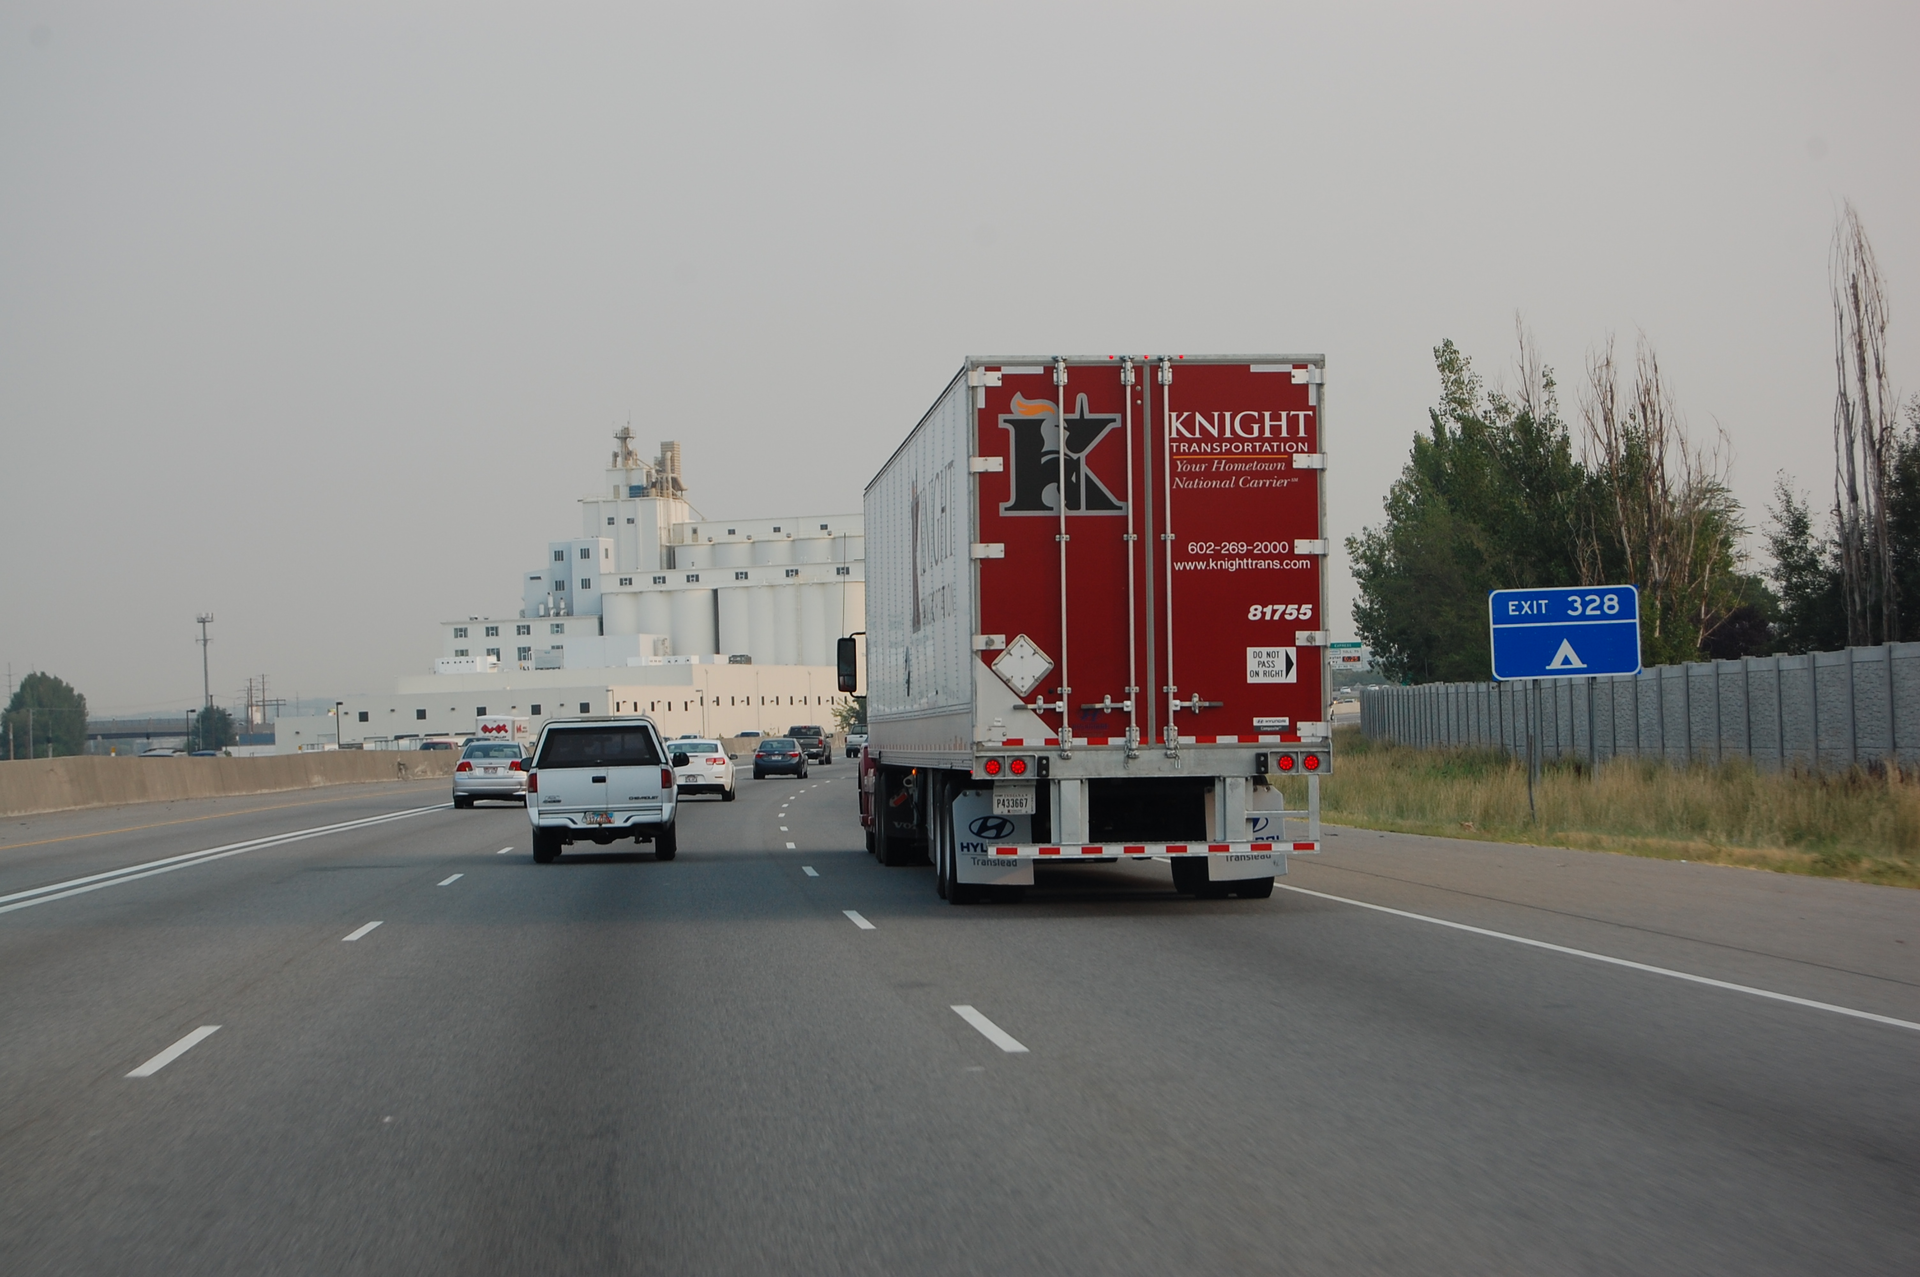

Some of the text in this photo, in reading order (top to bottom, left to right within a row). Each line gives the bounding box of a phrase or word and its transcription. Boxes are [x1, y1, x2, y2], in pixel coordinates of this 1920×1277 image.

[1169, 410, 1313, 438] KNIGHT
[1170, 442, 1308, 453] TRANSPORTATION
[1176, 459, 1286, 472] Your Hometown
[1172, 476, 1236, 489] National
[1187, 541, 1289, 554] 602-269-2000
[1173, 557, 1311, 572] www.knighttrans.com
[1508, 594, 1620, 616] EXIT 328
[1247, 604, 1313, 621] 81755
[1252, 650, 1280, 659] DO NOT
[1257, 660, 1276, 669] PASS
[1249, 669, 1283, 678] ON RIGHT
[996, 798, 1029, 809] P433667
[971, 857, 1018, 867] Translead
